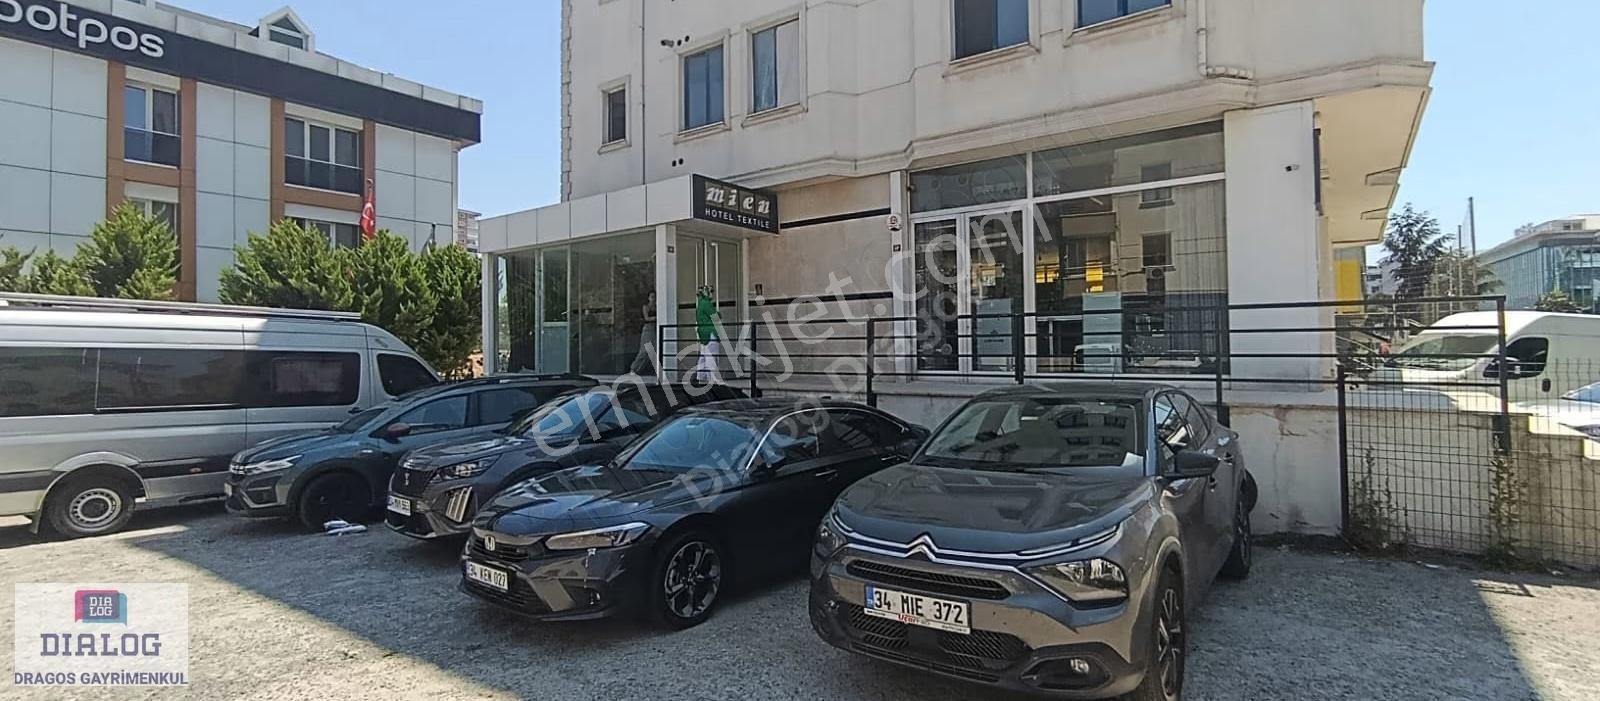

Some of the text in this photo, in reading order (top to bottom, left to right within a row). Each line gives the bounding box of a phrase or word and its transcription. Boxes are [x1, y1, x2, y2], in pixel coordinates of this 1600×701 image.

[705, 187, 771, 213] mien
[705, 208, 770, 229] HOTEL TEXTILE
[494, 571, 506, 587] 027
[875, 590, 963, 624] 34 MIE 372
